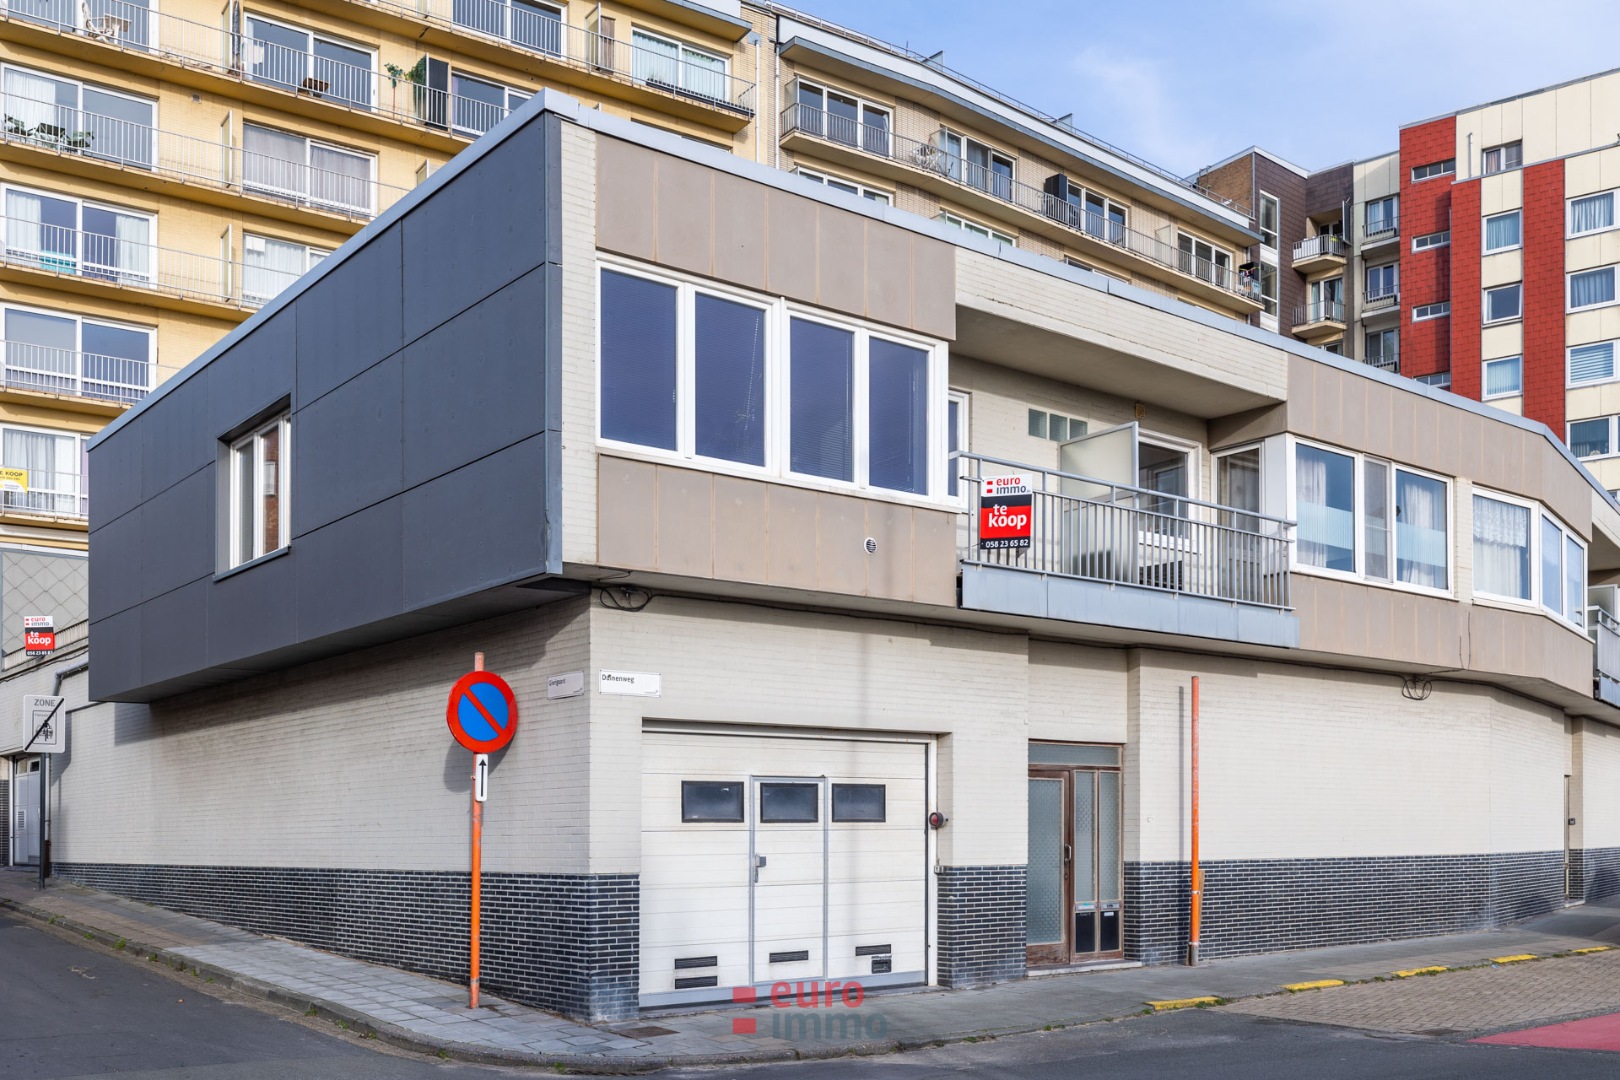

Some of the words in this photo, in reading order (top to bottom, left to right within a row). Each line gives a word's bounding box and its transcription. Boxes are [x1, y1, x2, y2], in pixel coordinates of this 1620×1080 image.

[996, 477, 1021, 486] euro
[996, 486, 1026, 494] immo
[993, 504, 1008, 515] te
[988, 513, 1027, 530] koop
[28, 636, 51, 646] koop
[34, 698, 56, 706] ZONE
